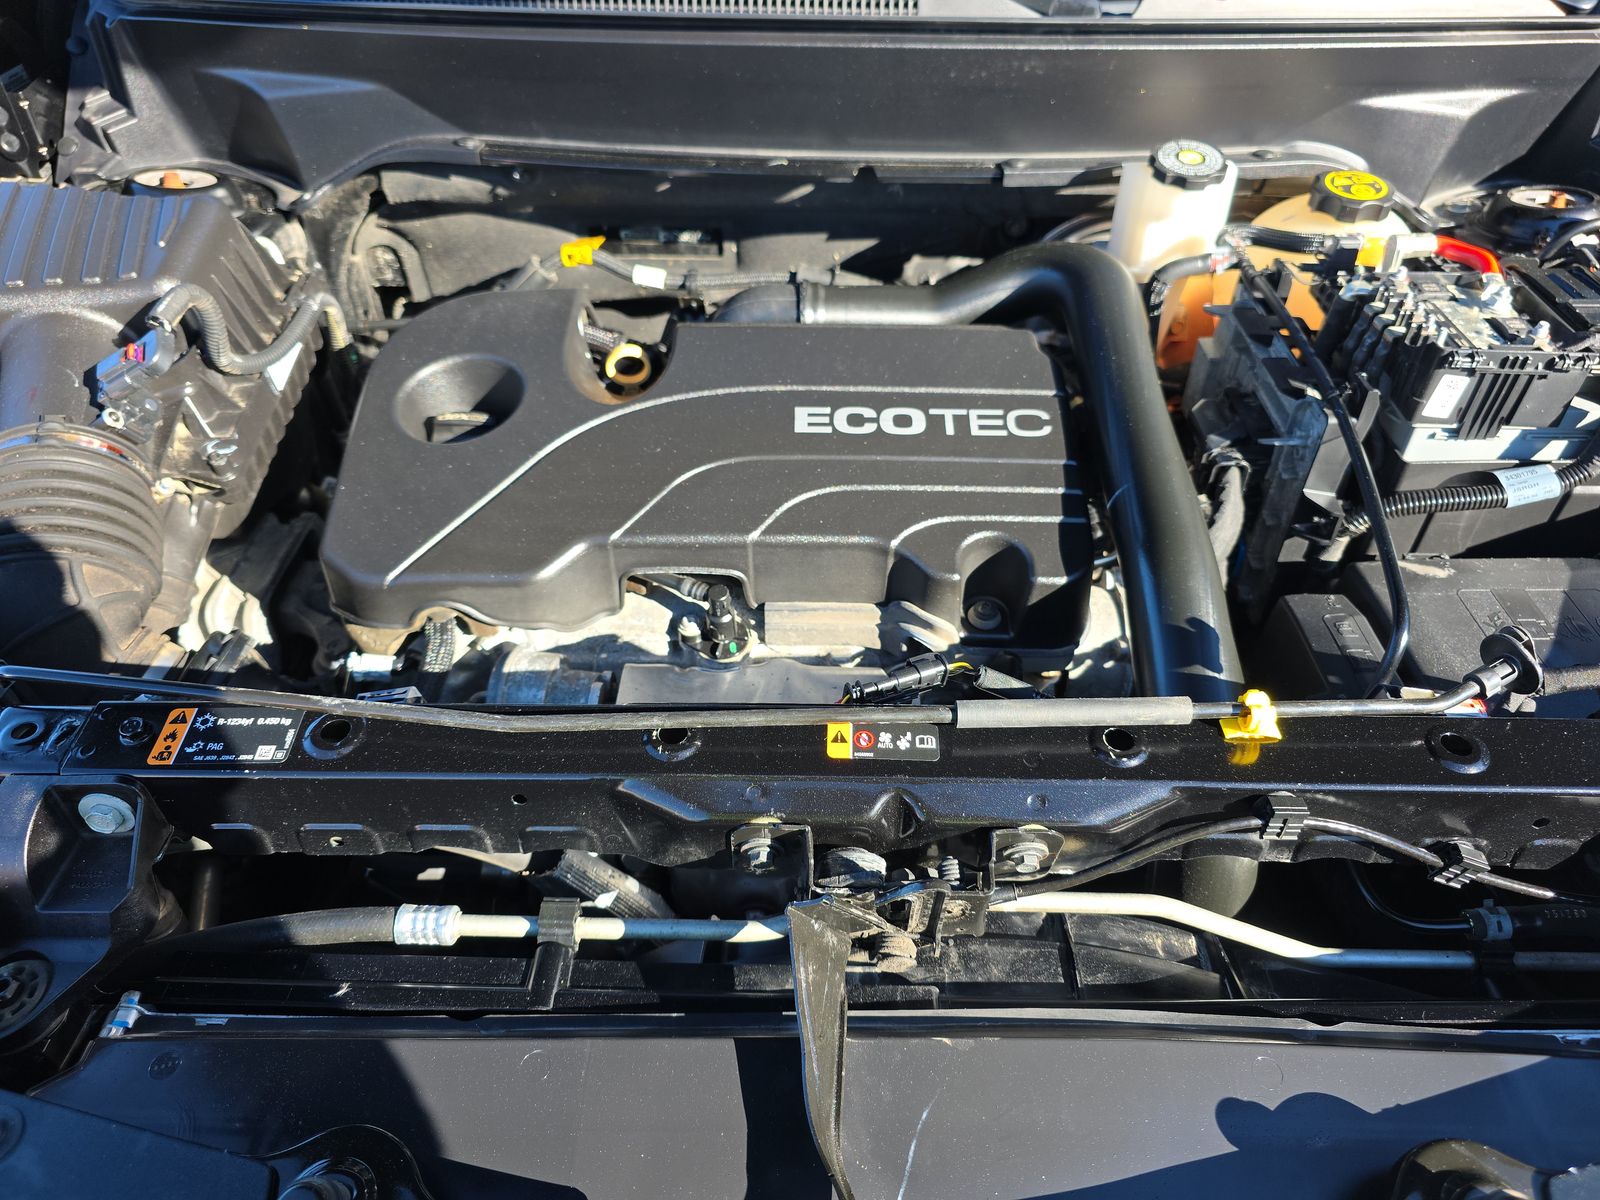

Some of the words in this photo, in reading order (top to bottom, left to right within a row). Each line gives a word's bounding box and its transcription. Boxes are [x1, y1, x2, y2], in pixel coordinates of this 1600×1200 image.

[794, 406, 1052, 437] ECOTEC
[217, 718, 254, 726] R-1234yf
[280, 718, 292, 726] kg
